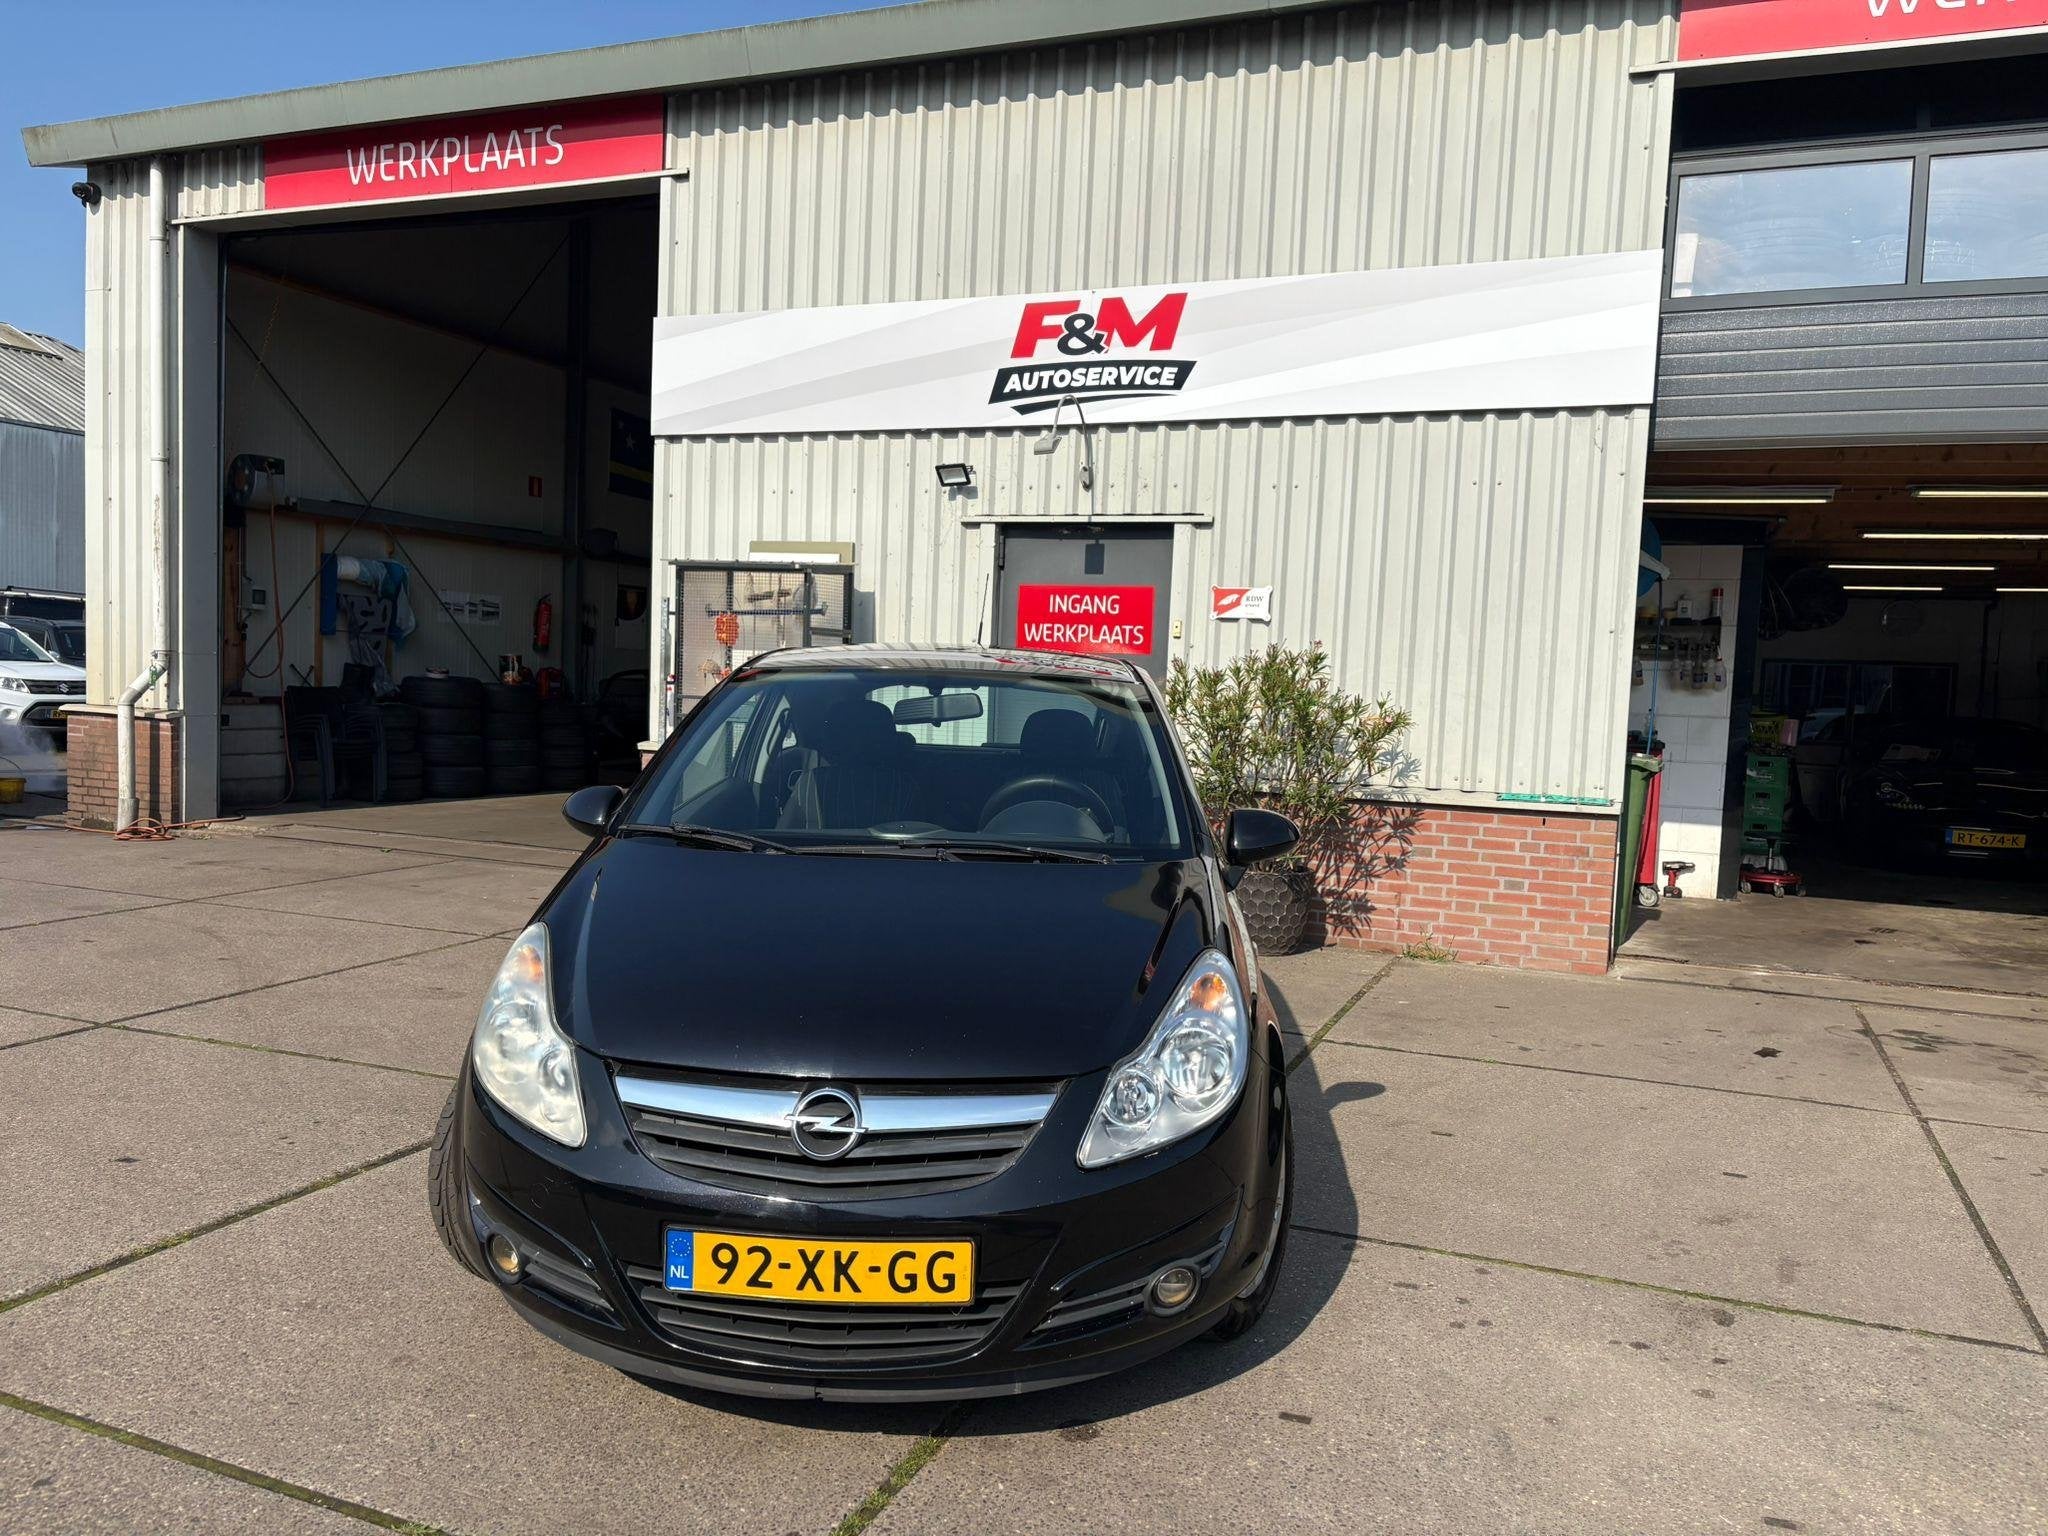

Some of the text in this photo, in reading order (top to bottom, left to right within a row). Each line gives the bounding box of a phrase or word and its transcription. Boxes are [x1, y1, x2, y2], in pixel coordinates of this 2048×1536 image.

[347, 124, 564, 185] WERKPLAATS
[1011, 292, 1188, 358] F&M
[1003, 366, 1178, 393] AUTOSERVICE
[1049, 594, 1121, 614] INGANG
[1024, 623, 1144, 645] WERKPLAATS
[1957, 832, 2020, 847] RT-674-K
[670, 1242, 956, 1294] NL 92-XK-GG
